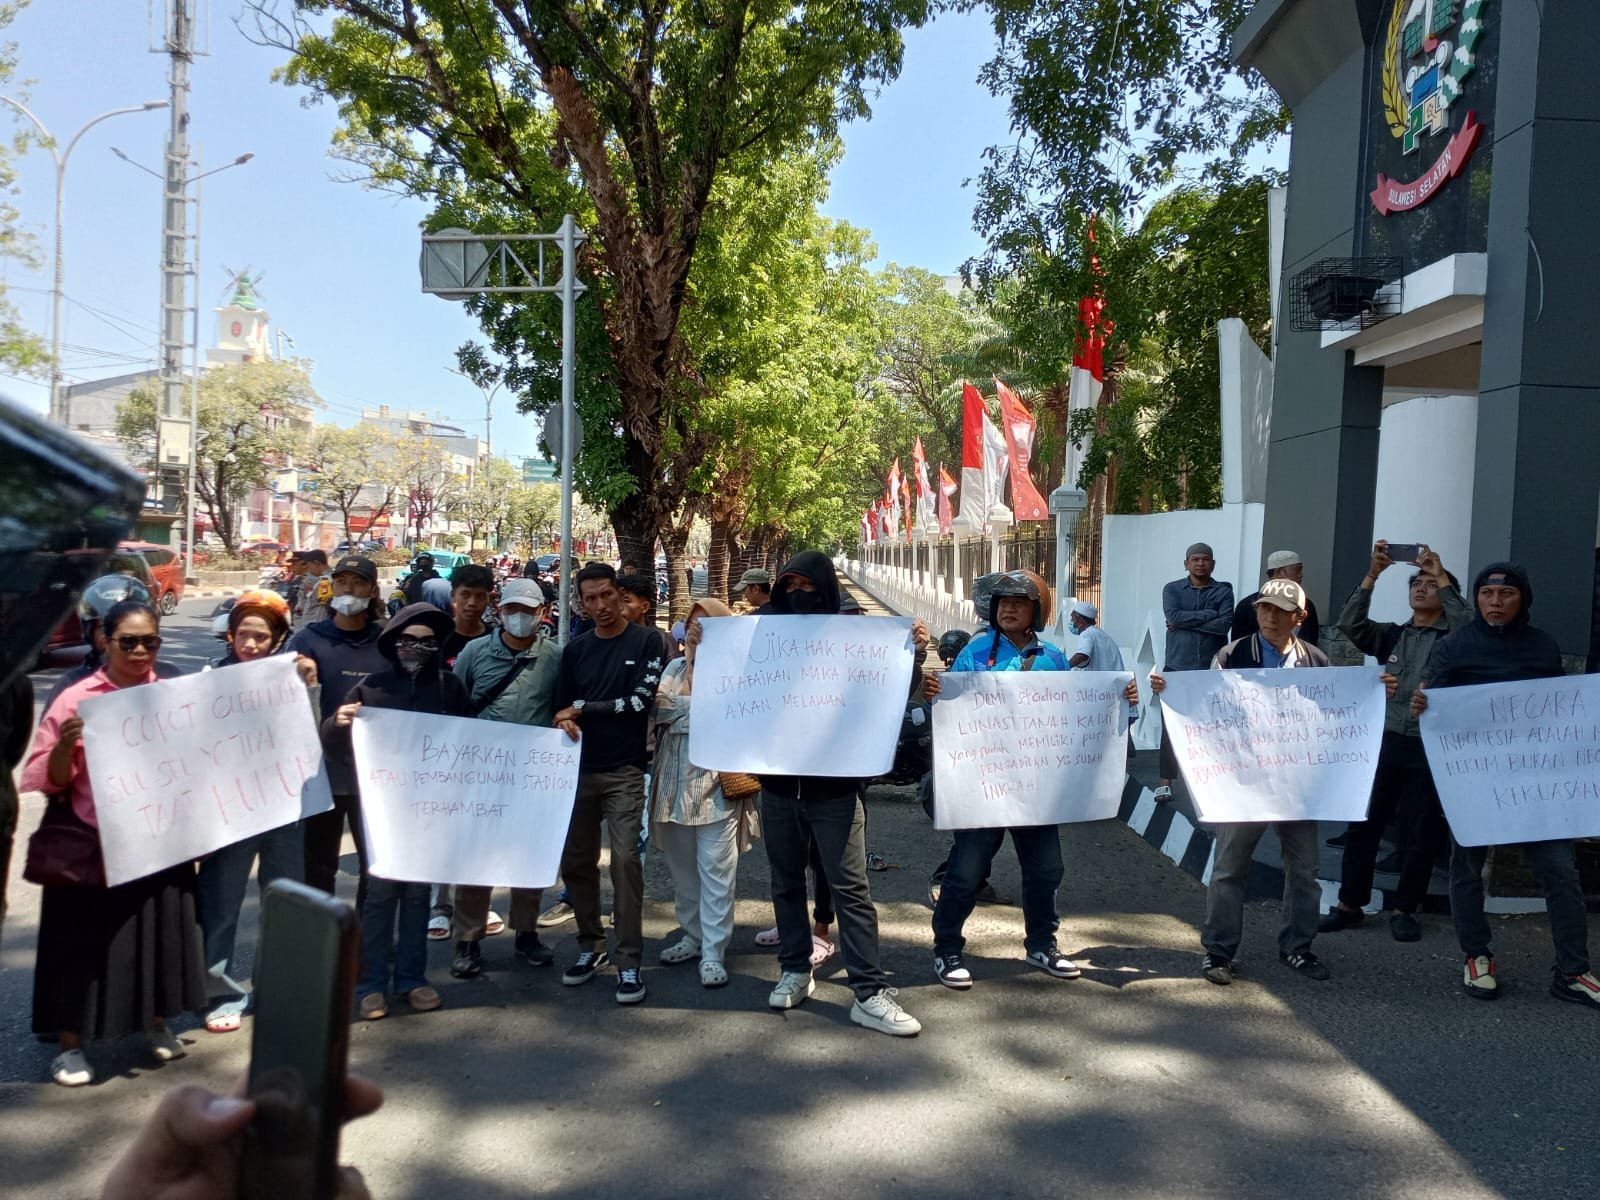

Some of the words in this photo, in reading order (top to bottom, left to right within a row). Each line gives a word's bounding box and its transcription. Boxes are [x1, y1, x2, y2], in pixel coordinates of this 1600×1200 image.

[1389, 188, 1417, 206] SULAWESI
[1420, 148, 1452, 198] SELATAN
[1262, 581, 1295, 598] NYC
[805, 640, 835, 658] HAK
[801, 666, 839, 682] MAKA
[725, 698, 771, 720] AKAN
[782, 693, 846, 709] MELAWAN
[1211, 687, 1265, 715] AMAR
[1275, 682, 1335, 702] PUTUSAN
[1490, 689, 1587, 723] NEGARA
[1020, 716, 1069, 730] TANAH
[1317, 724, 1369, 744] BUKAN
[1440, 728, 1519, 753] INDONESIA
[1528, 724, 1584, 744] ADALAH
[422, 734, 516, 769] BAYARKAN
[524, 749, 576, 766] SEGERA
[1256, 752, 1298, 768] BAHAN
[1446, 755, 1498, 776] HUKUM
[1509, 752, 1564, 771] BUKAN
[370, 769, 405, 787] ATAU
[413, 770, 515, 788] PEMBANGUNAN
[411, 802, 512, 819] TERHAMBAT
